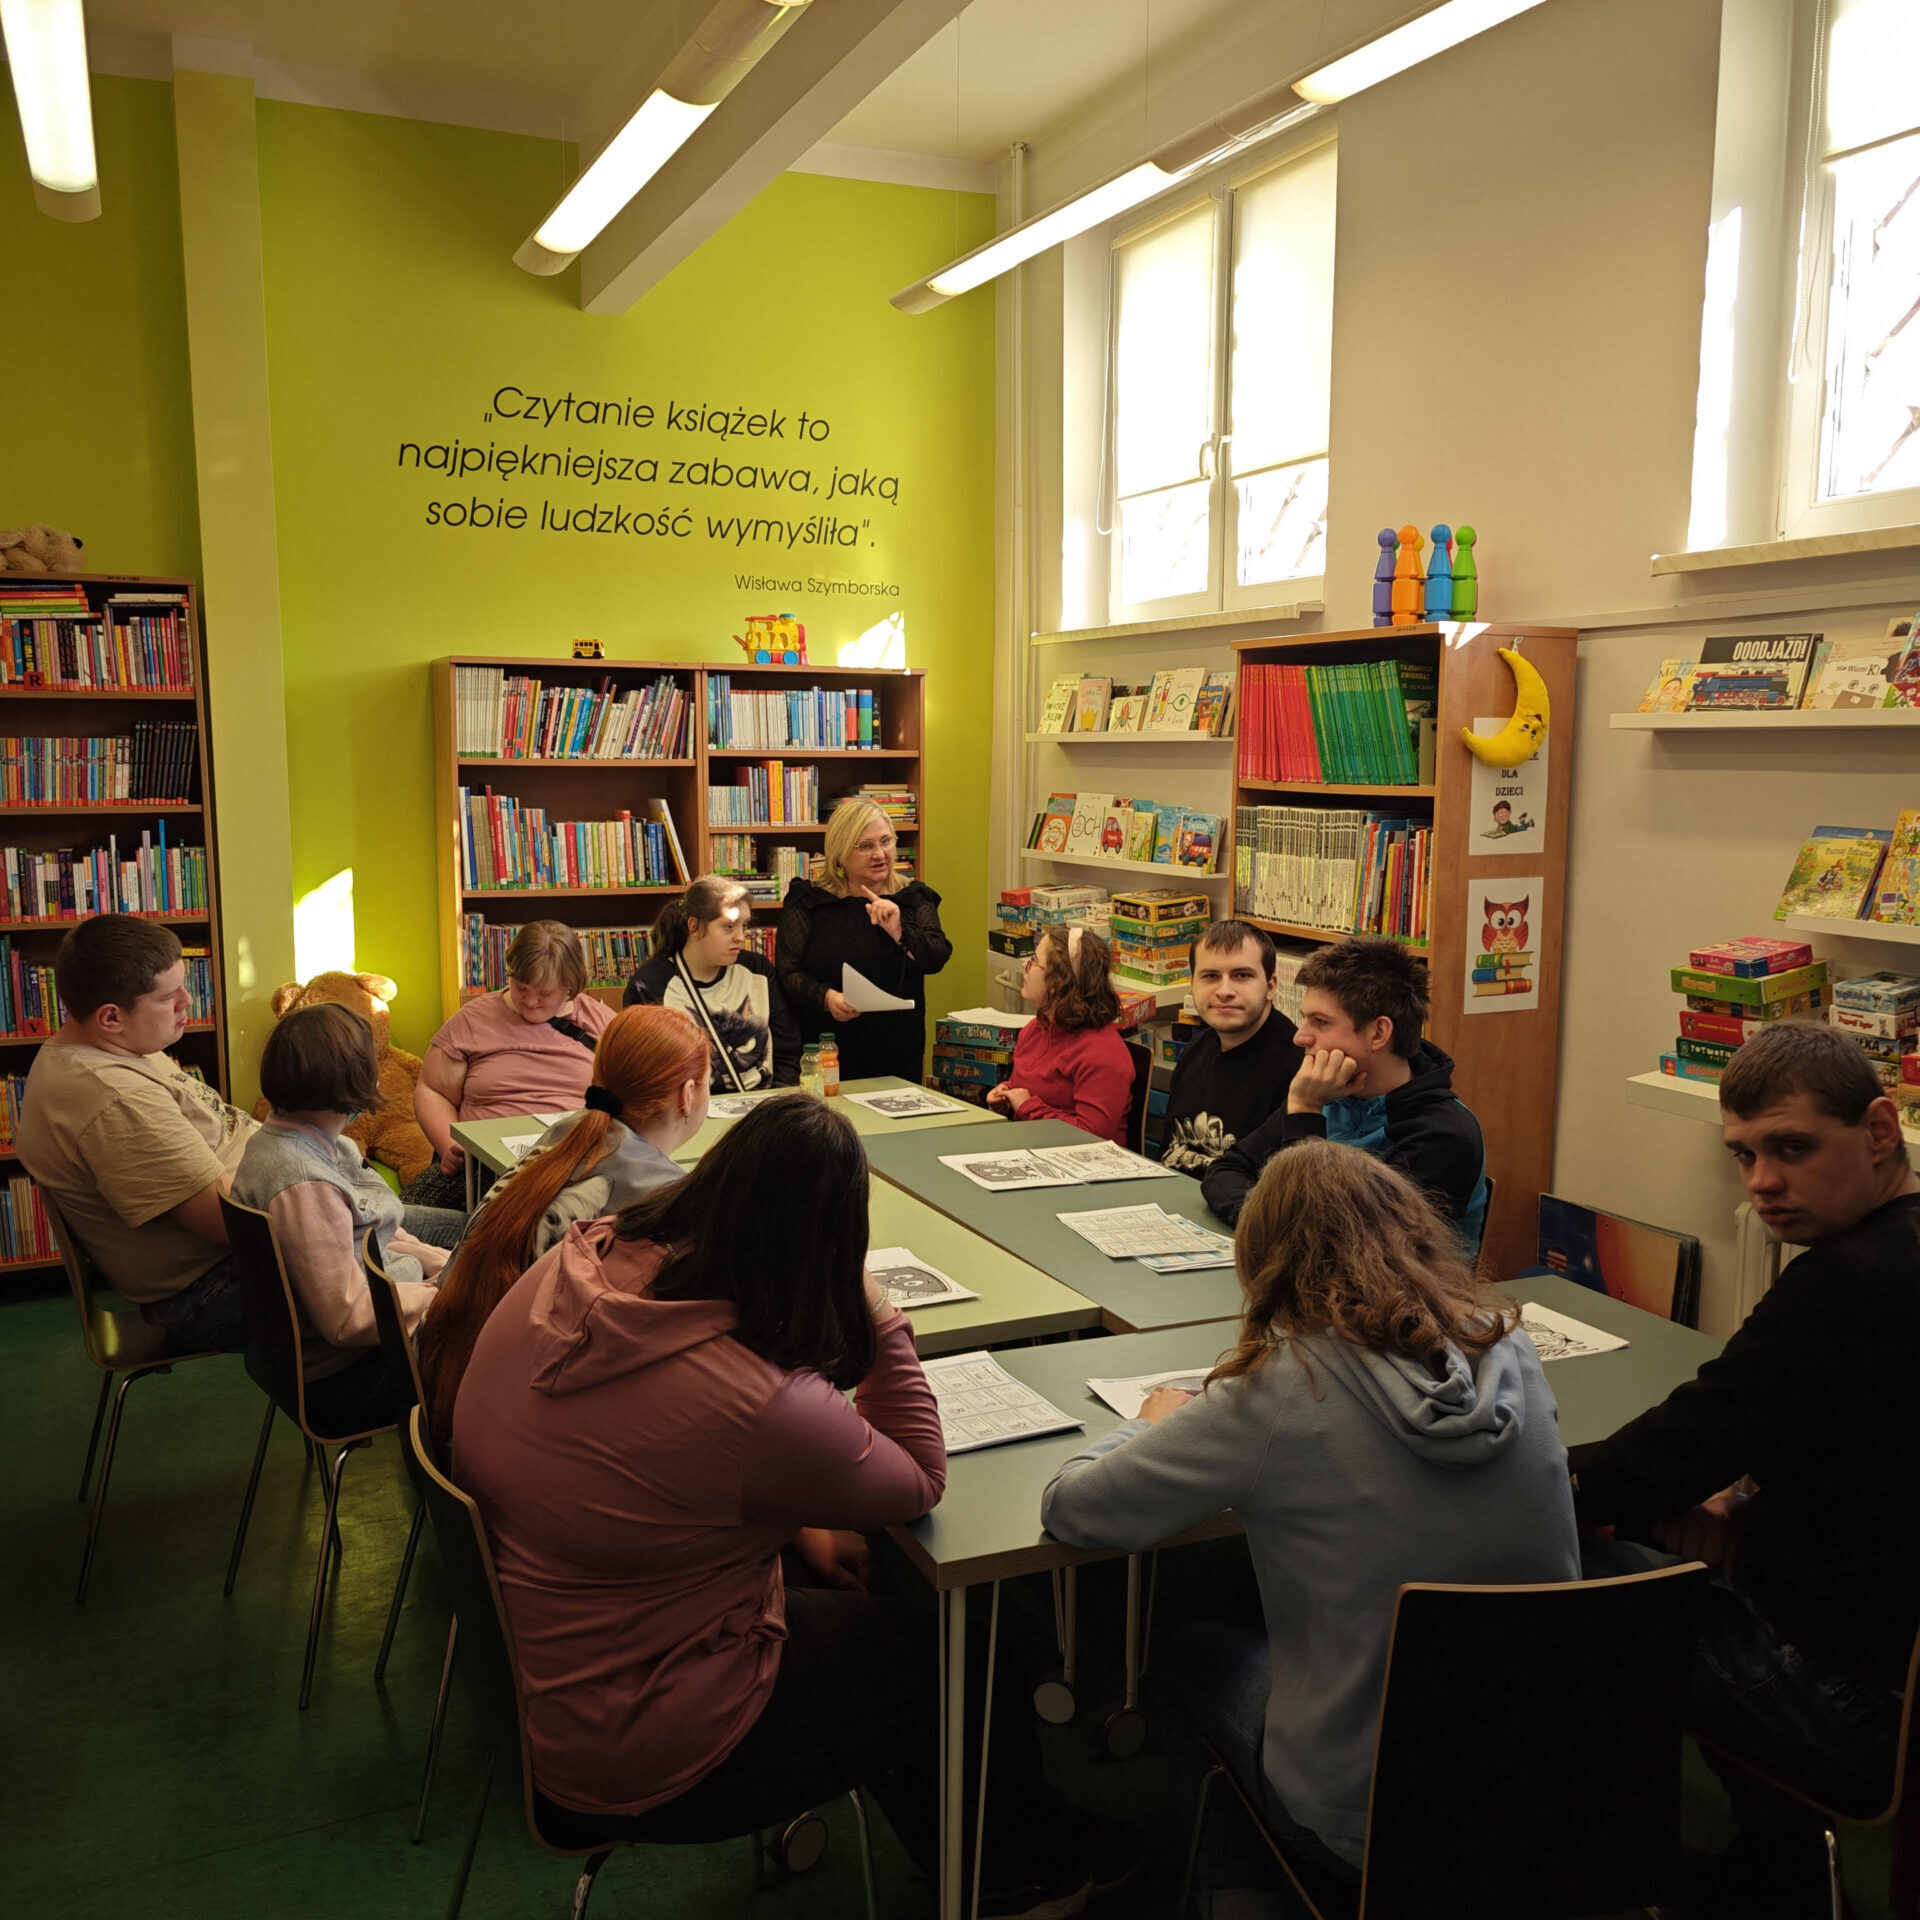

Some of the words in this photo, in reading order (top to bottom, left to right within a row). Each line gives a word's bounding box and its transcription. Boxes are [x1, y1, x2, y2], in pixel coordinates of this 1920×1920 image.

[484, 386, 655, 429] „Czytanie
[667, 400, 787, 442] książek
[798, 411, 831, 442] to
[398, 439, 659, 486] najpiękniejsza
[669, 457, 819, 495] zabawa,
[826, 465, 899, 506] jaką
[425, 496, 528, 530] sobie
[540, 500, 693, 537] ludzkość
[735, 574, 802, 592] Wisława
[807, 577, 900, 597] Szymborska
[1733, 640, 1809, 660] OOODJAZD!
[30, 675, 42, 686] R
[1501, 769, 1519, 779] DLA
[1495, 787, 1524, 796] DZIECI
[29, 1023, 40, 1033] V
